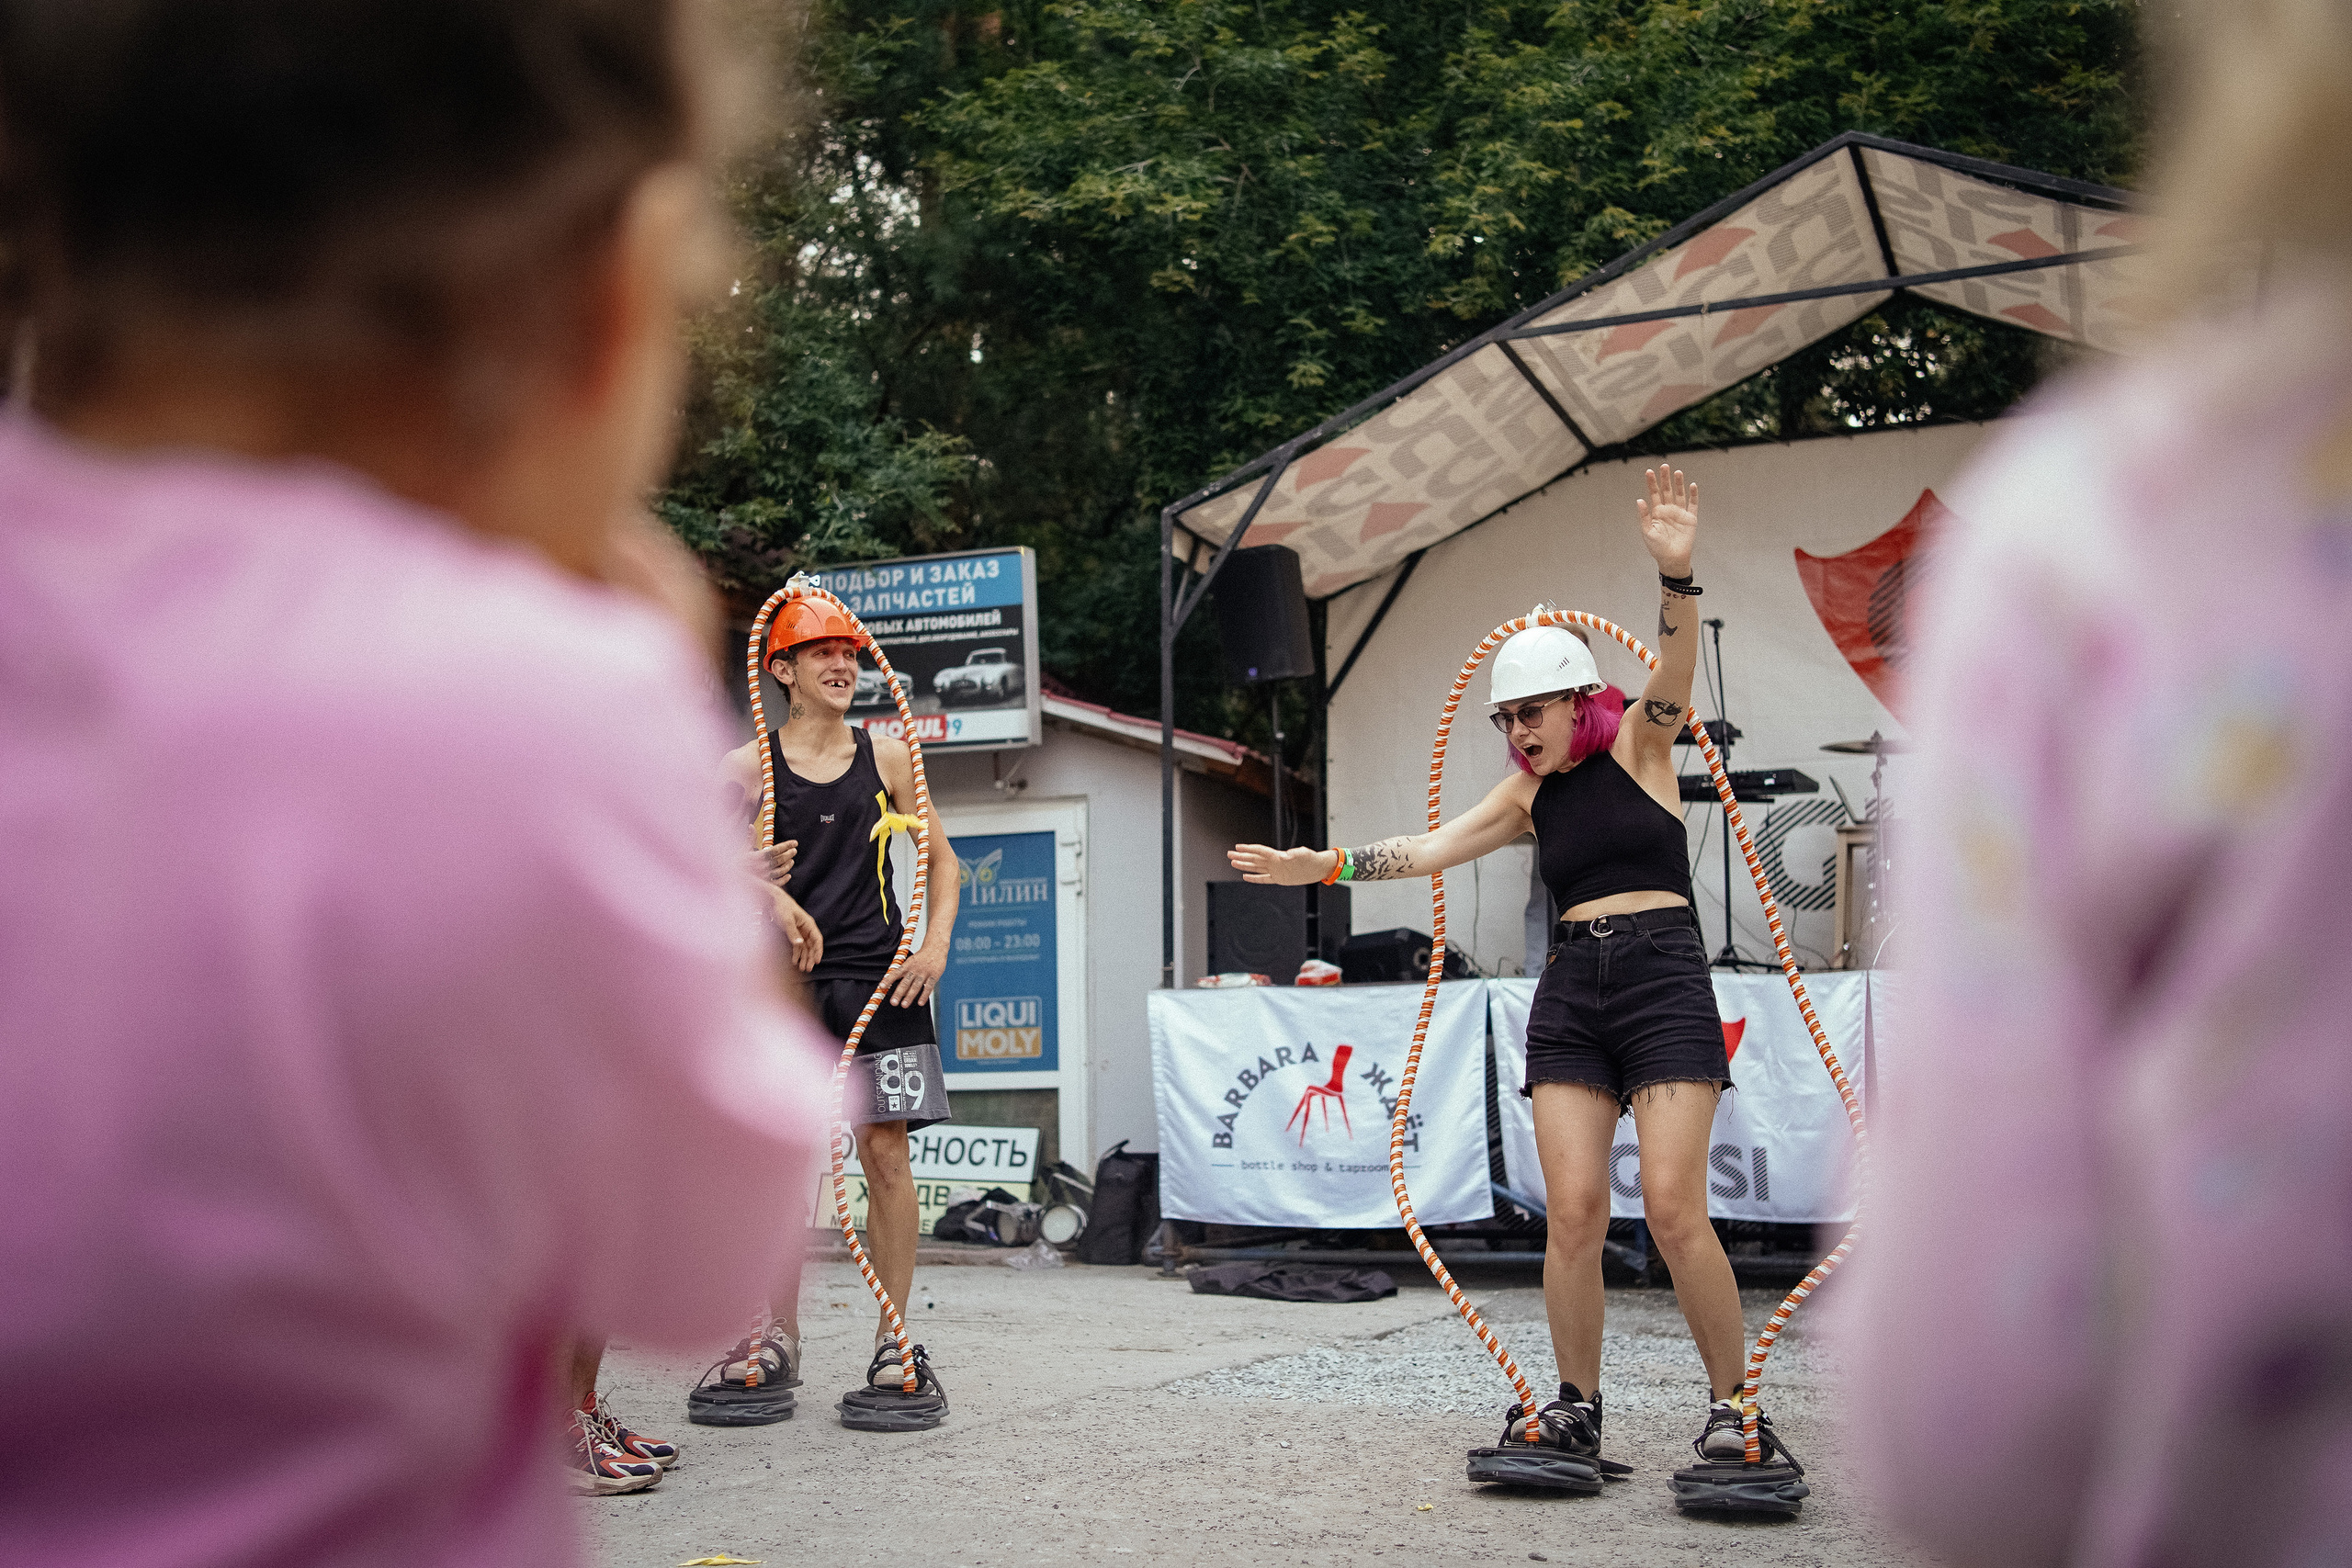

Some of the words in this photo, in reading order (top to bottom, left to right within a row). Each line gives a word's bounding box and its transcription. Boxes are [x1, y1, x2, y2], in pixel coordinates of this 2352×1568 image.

[910, 567, 924, 585] И
[930, 559, 1000, 583] ЗАКАЗ
[850, 582, 975, 614] ЗАПЧАСТЕЙ
[905, 609, 1001, 632] АВТОМОБИЛЕЙ
[868, 718, 944, 739] MOUL
[961, 1000, 1036, 1028] LIQUI
[961, 1030, 1039, 1056] MOLY
[874, 1053, 887, 1113] OUTSTANDING
[1213, 1042, 1319, 1148] BARBARA
[1241, 1160, 1284, 1170] bottle
[1292, 1161, 1317, 1173] shop
[1325, 1162, 1332, 1172] &
[1340, 1163, 1389, 1174] taproom
[1609, 1143, 1770, 1201] GSI
